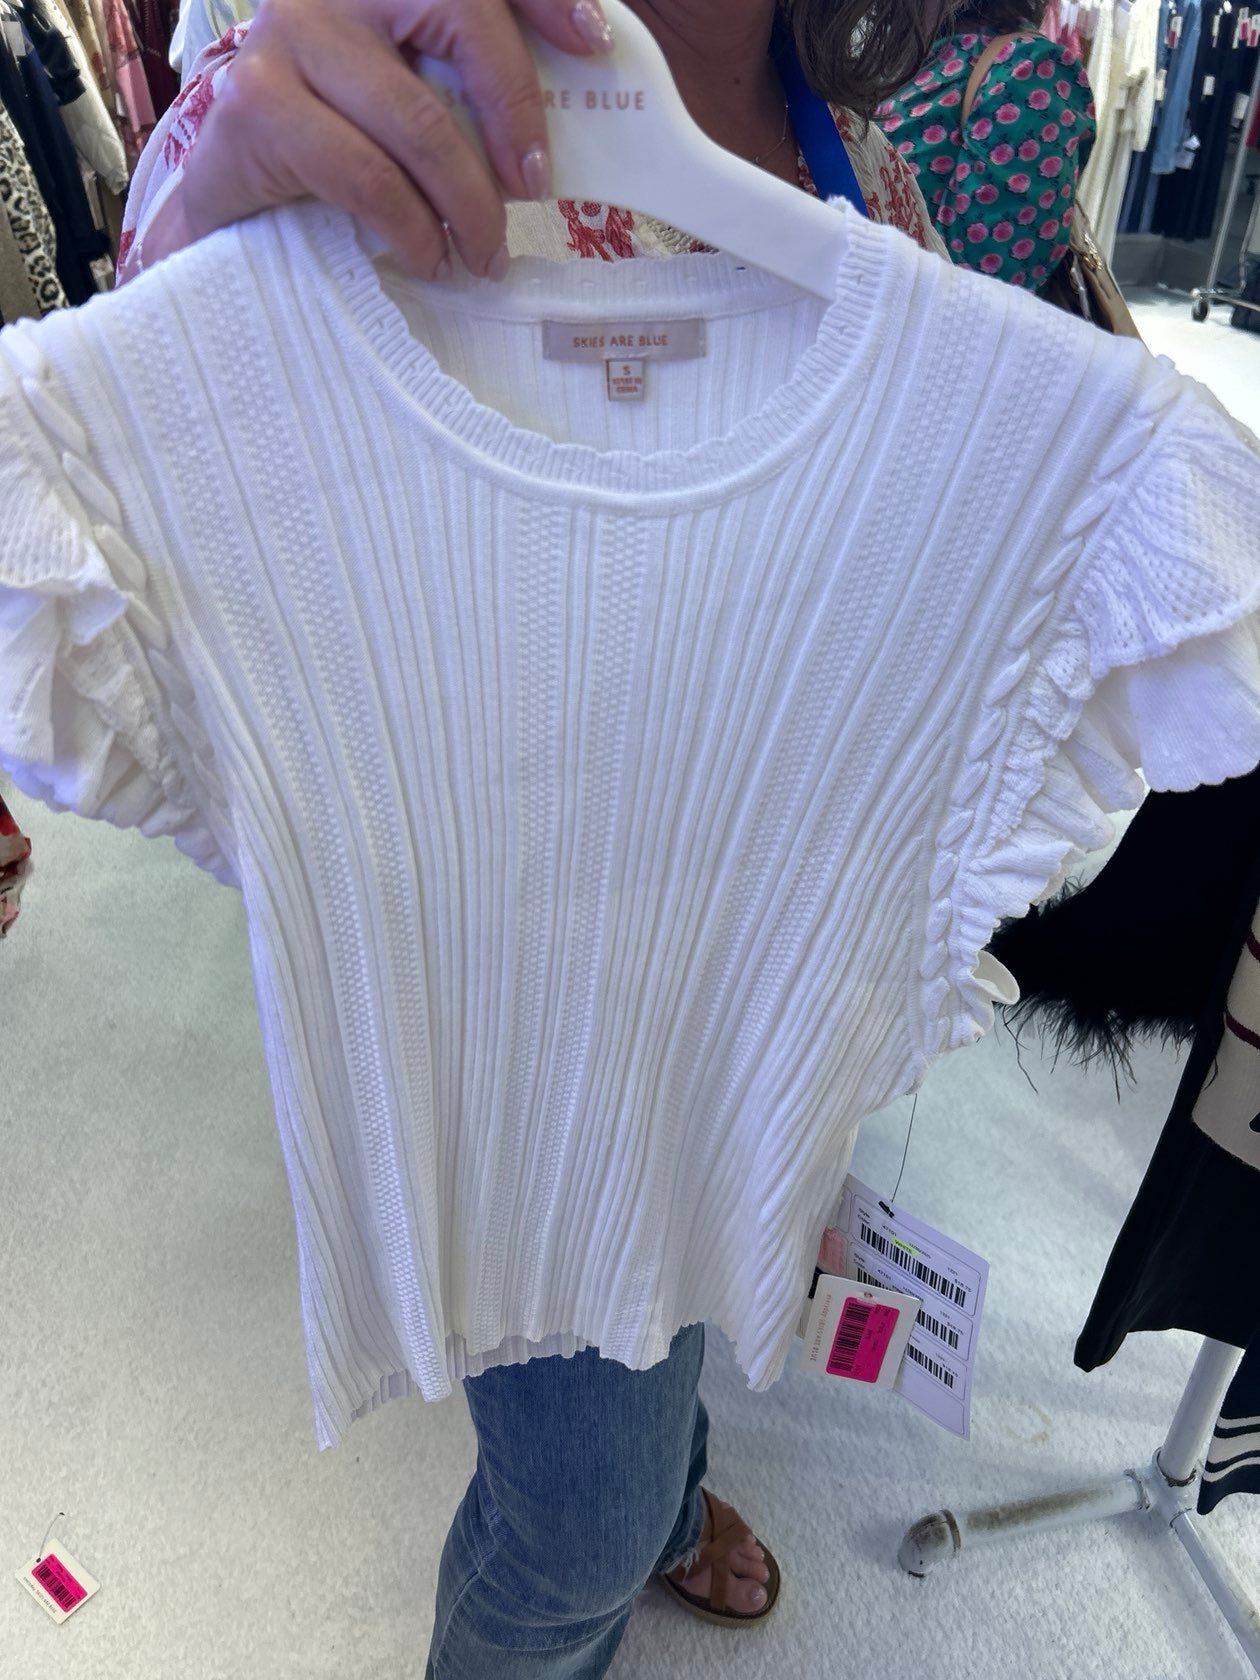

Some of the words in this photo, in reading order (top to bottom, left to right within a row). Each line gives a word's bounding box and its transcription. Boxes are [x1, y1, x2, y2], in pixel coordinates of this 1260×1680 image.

[543, 89, 571, 110] RE
[584, 90, 645, 110] BLUE
[573, 336, 605, 348] SKIES
[610, 335, 634, 347] ARE
[638, 335, 669, 347] BLUE
[623, 365, 631, 375] S
